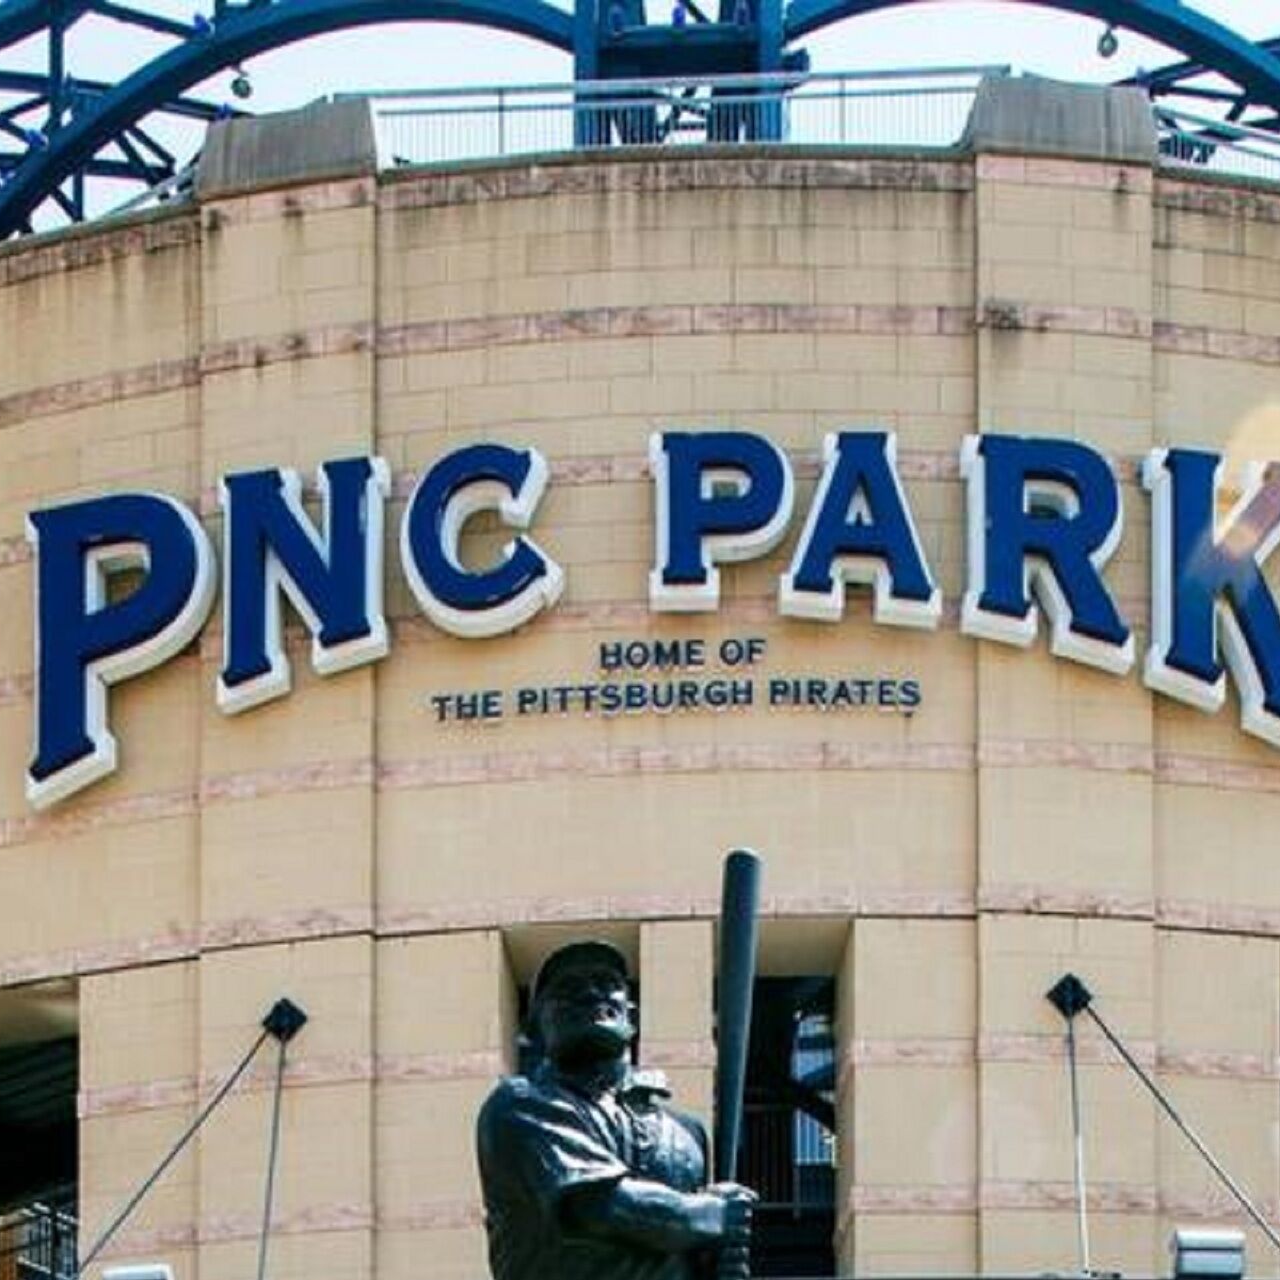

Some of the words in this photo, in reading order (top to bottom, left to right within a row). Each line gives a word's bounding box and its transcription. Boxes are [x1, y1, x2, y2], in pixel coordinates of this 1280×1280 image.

[25, 444, 566, 810] PNC
[600, 641, 705, 670] HOME
[719, 639, 767, 666] OF
[431, 690, 504, 722] THE
[519, 681, 754, 715] PITTSBURGH
[769, 680, 922, 708] PIRATES
